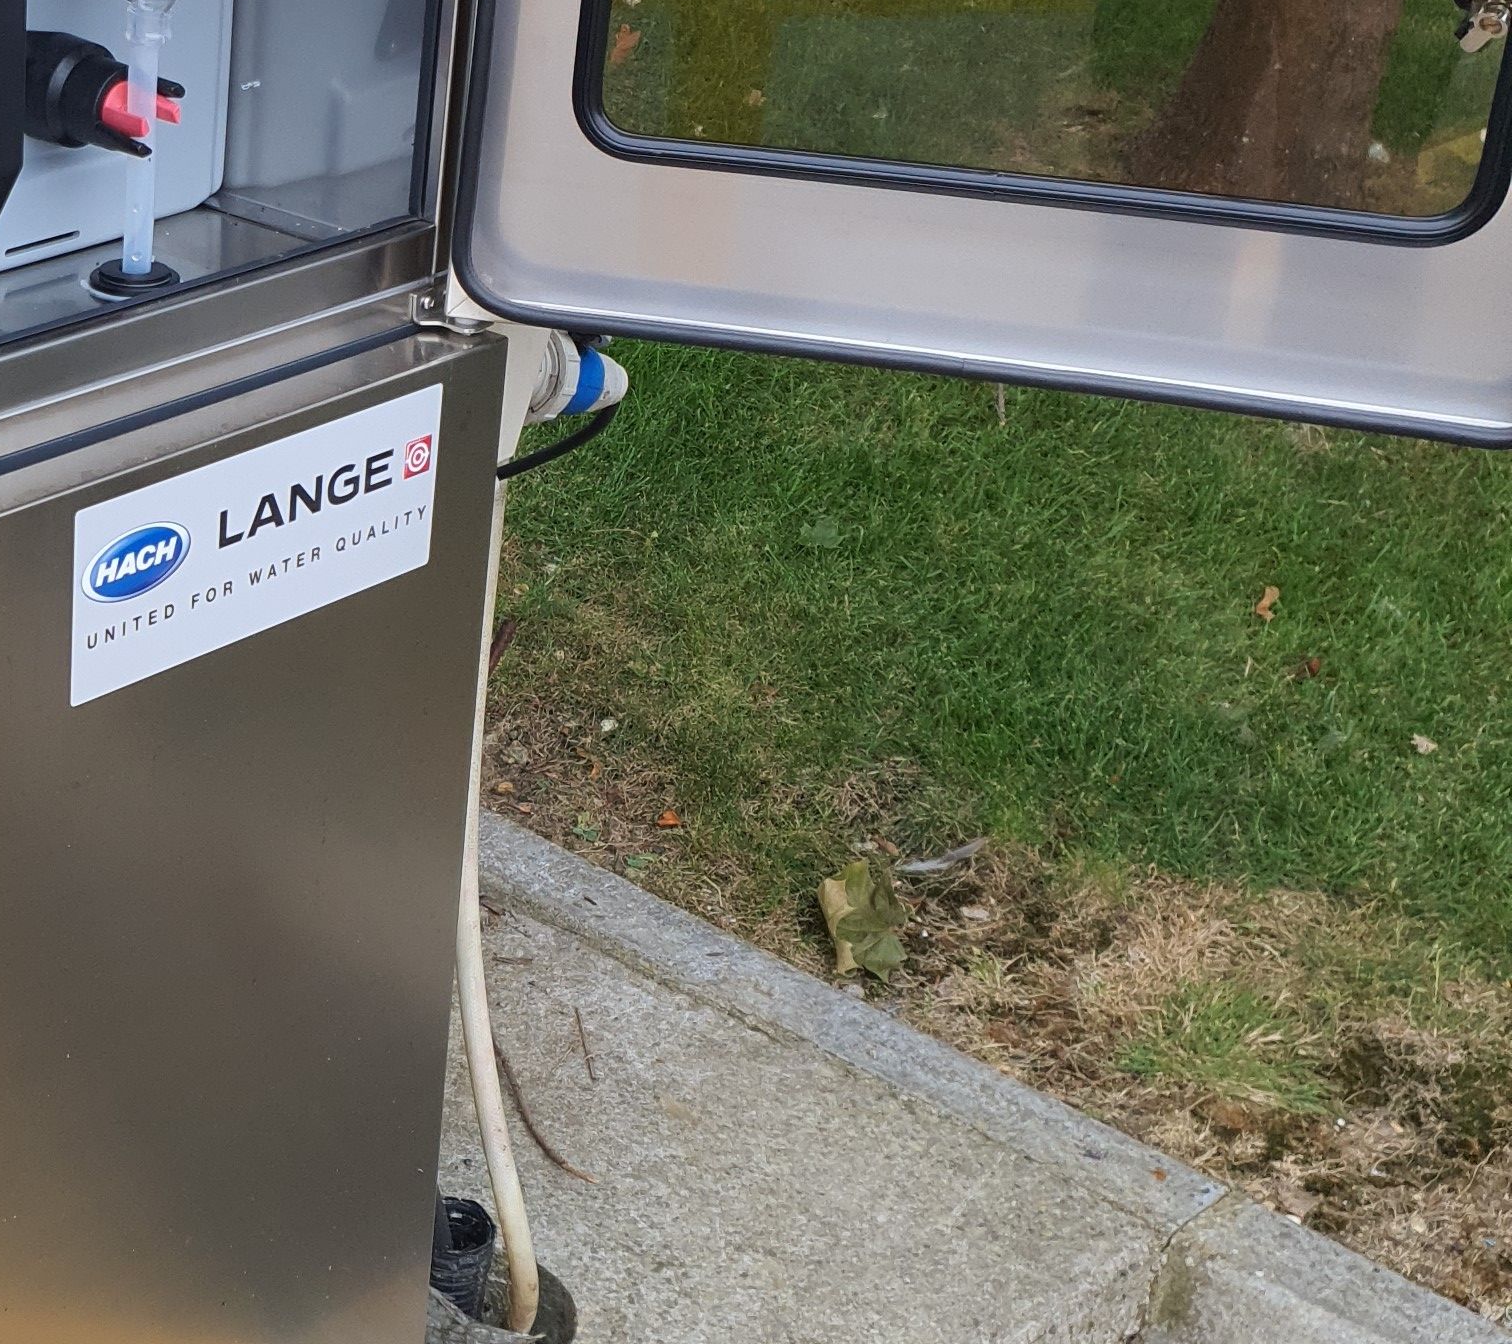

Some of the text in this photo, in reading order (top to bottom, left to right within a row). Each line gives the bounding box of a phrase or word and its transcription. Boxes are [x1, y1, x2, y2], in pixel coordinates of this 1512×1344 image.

[87, 505, 427, 649] UNITED FOR WATER QUALITY
[95, 448, 394, 589] HACH LANGE
